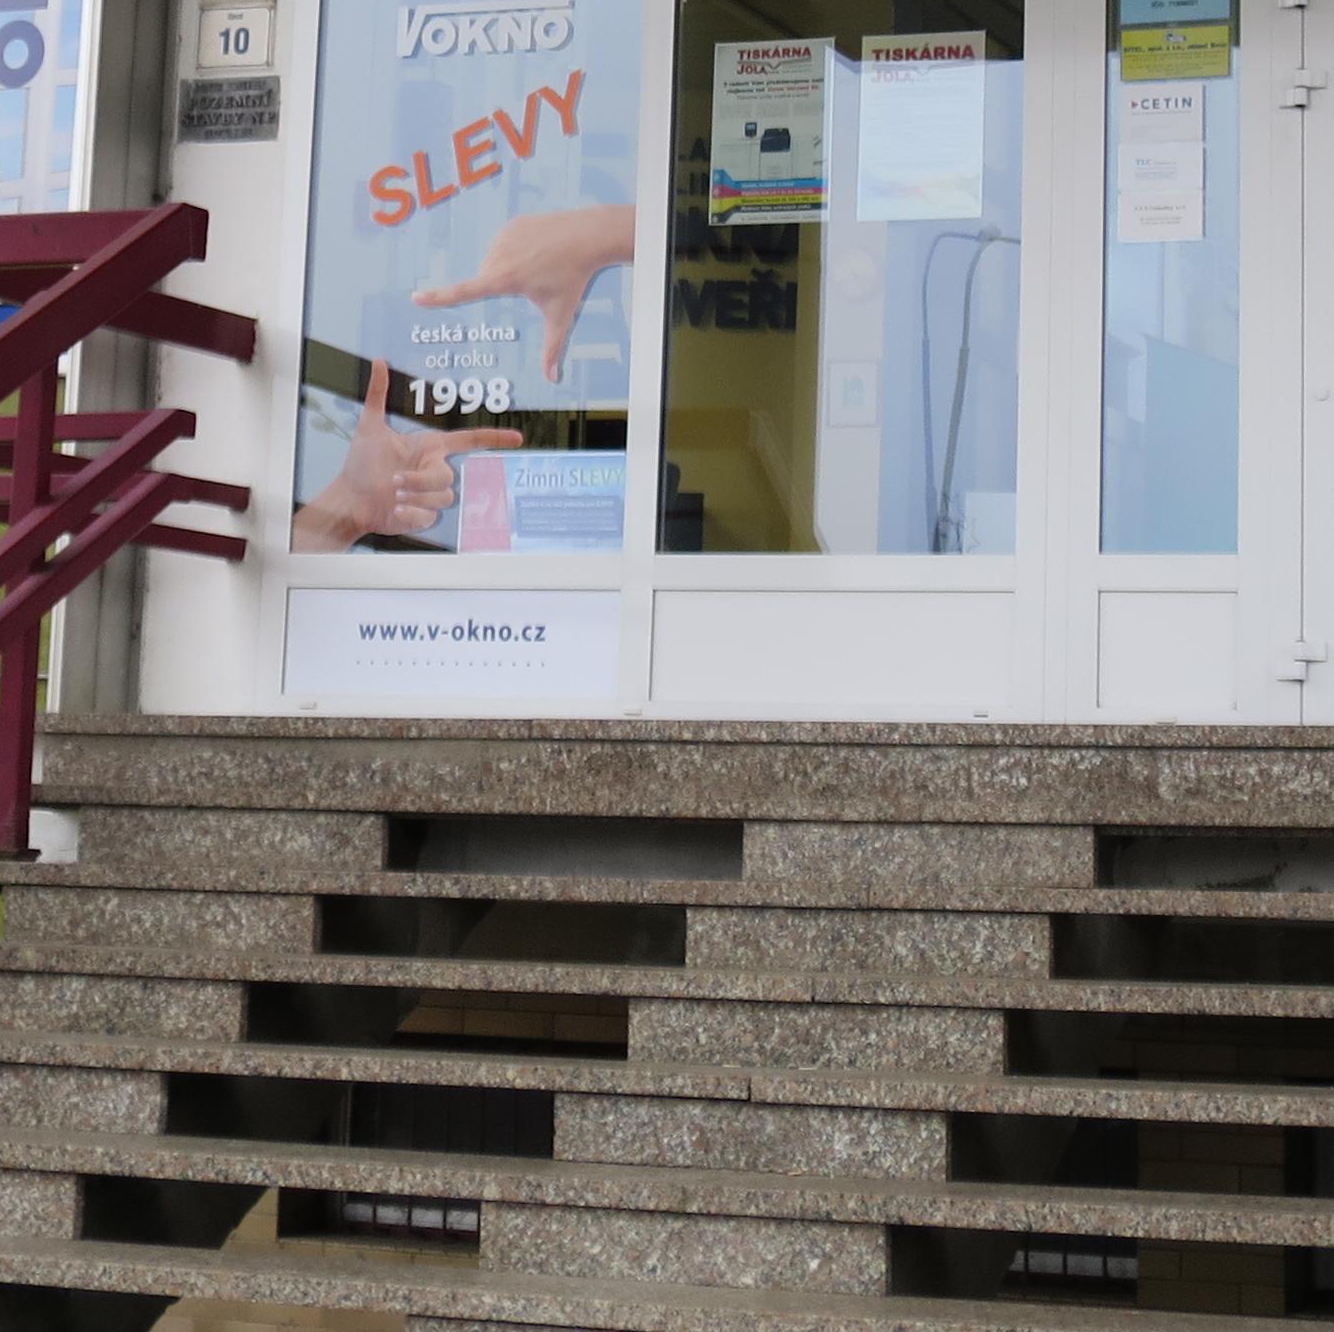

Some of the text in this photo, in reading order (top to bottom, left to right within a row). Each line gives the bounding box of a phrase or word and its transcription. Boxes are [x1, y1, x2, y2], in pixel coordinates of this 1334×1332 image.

[218, 27, 250, 56] 10
[872, 42, 976, 62] TISKÁRNA
[737, 46, 812, 61] TISKÁRNA
[1140, 96, 1193, 111] CETIN
[368, 68, 586, 228] SLEVY
[411, 323, 517, 344] česká okna
[425, 350, 495, 369] od roku
[408, 376, 512, 416] 1998
[514, 466, 624, 488] Zimní SLEVY
[358, 618, 547, 643] www.v-okno.cz
